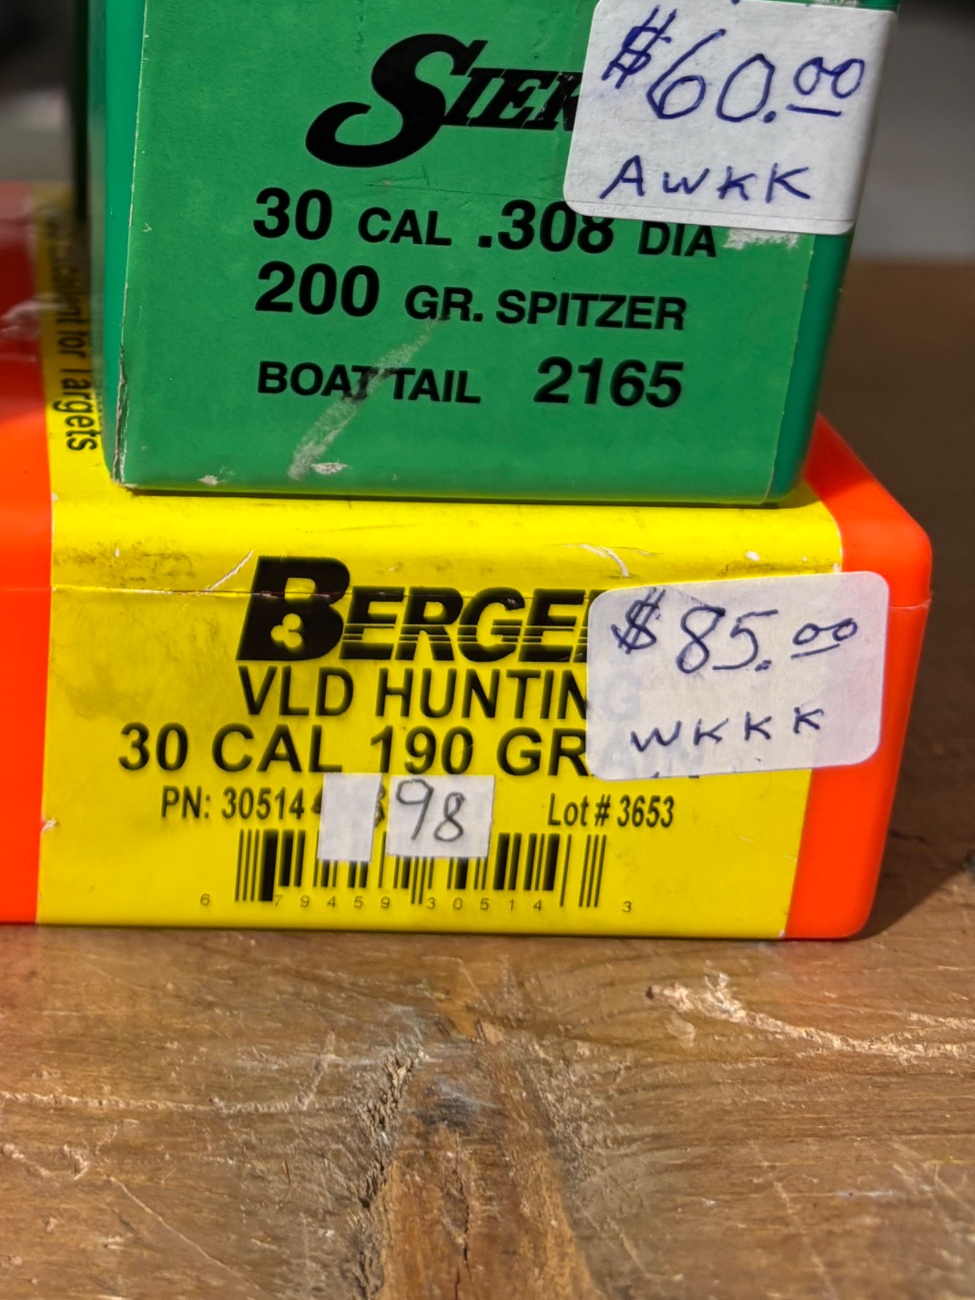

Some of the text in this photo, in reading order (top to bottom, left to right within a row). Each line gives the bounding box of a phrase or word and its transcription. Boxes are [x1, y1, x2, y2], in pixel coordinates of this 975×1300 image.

[252, 187, 717, 258] 30 CAL .308 DIA
[254, 260, 688, 331] 200 GR. SPITZER
[533, 355, 685, 409] 2165
[236, 555, 588, 663] BERGE
[238, 665, 589, 720] VLD HUNTIN
[118, 722, 189, 772] 30
[211, 723, 343, 773] CAL
[369, 725, 474, 776] 190
[160, 785, 210, 820] PN:
[547, 792, 590, 827] Lot
[617, 794, 675, 828] 3653
[394, 777, 468, 843] 98
